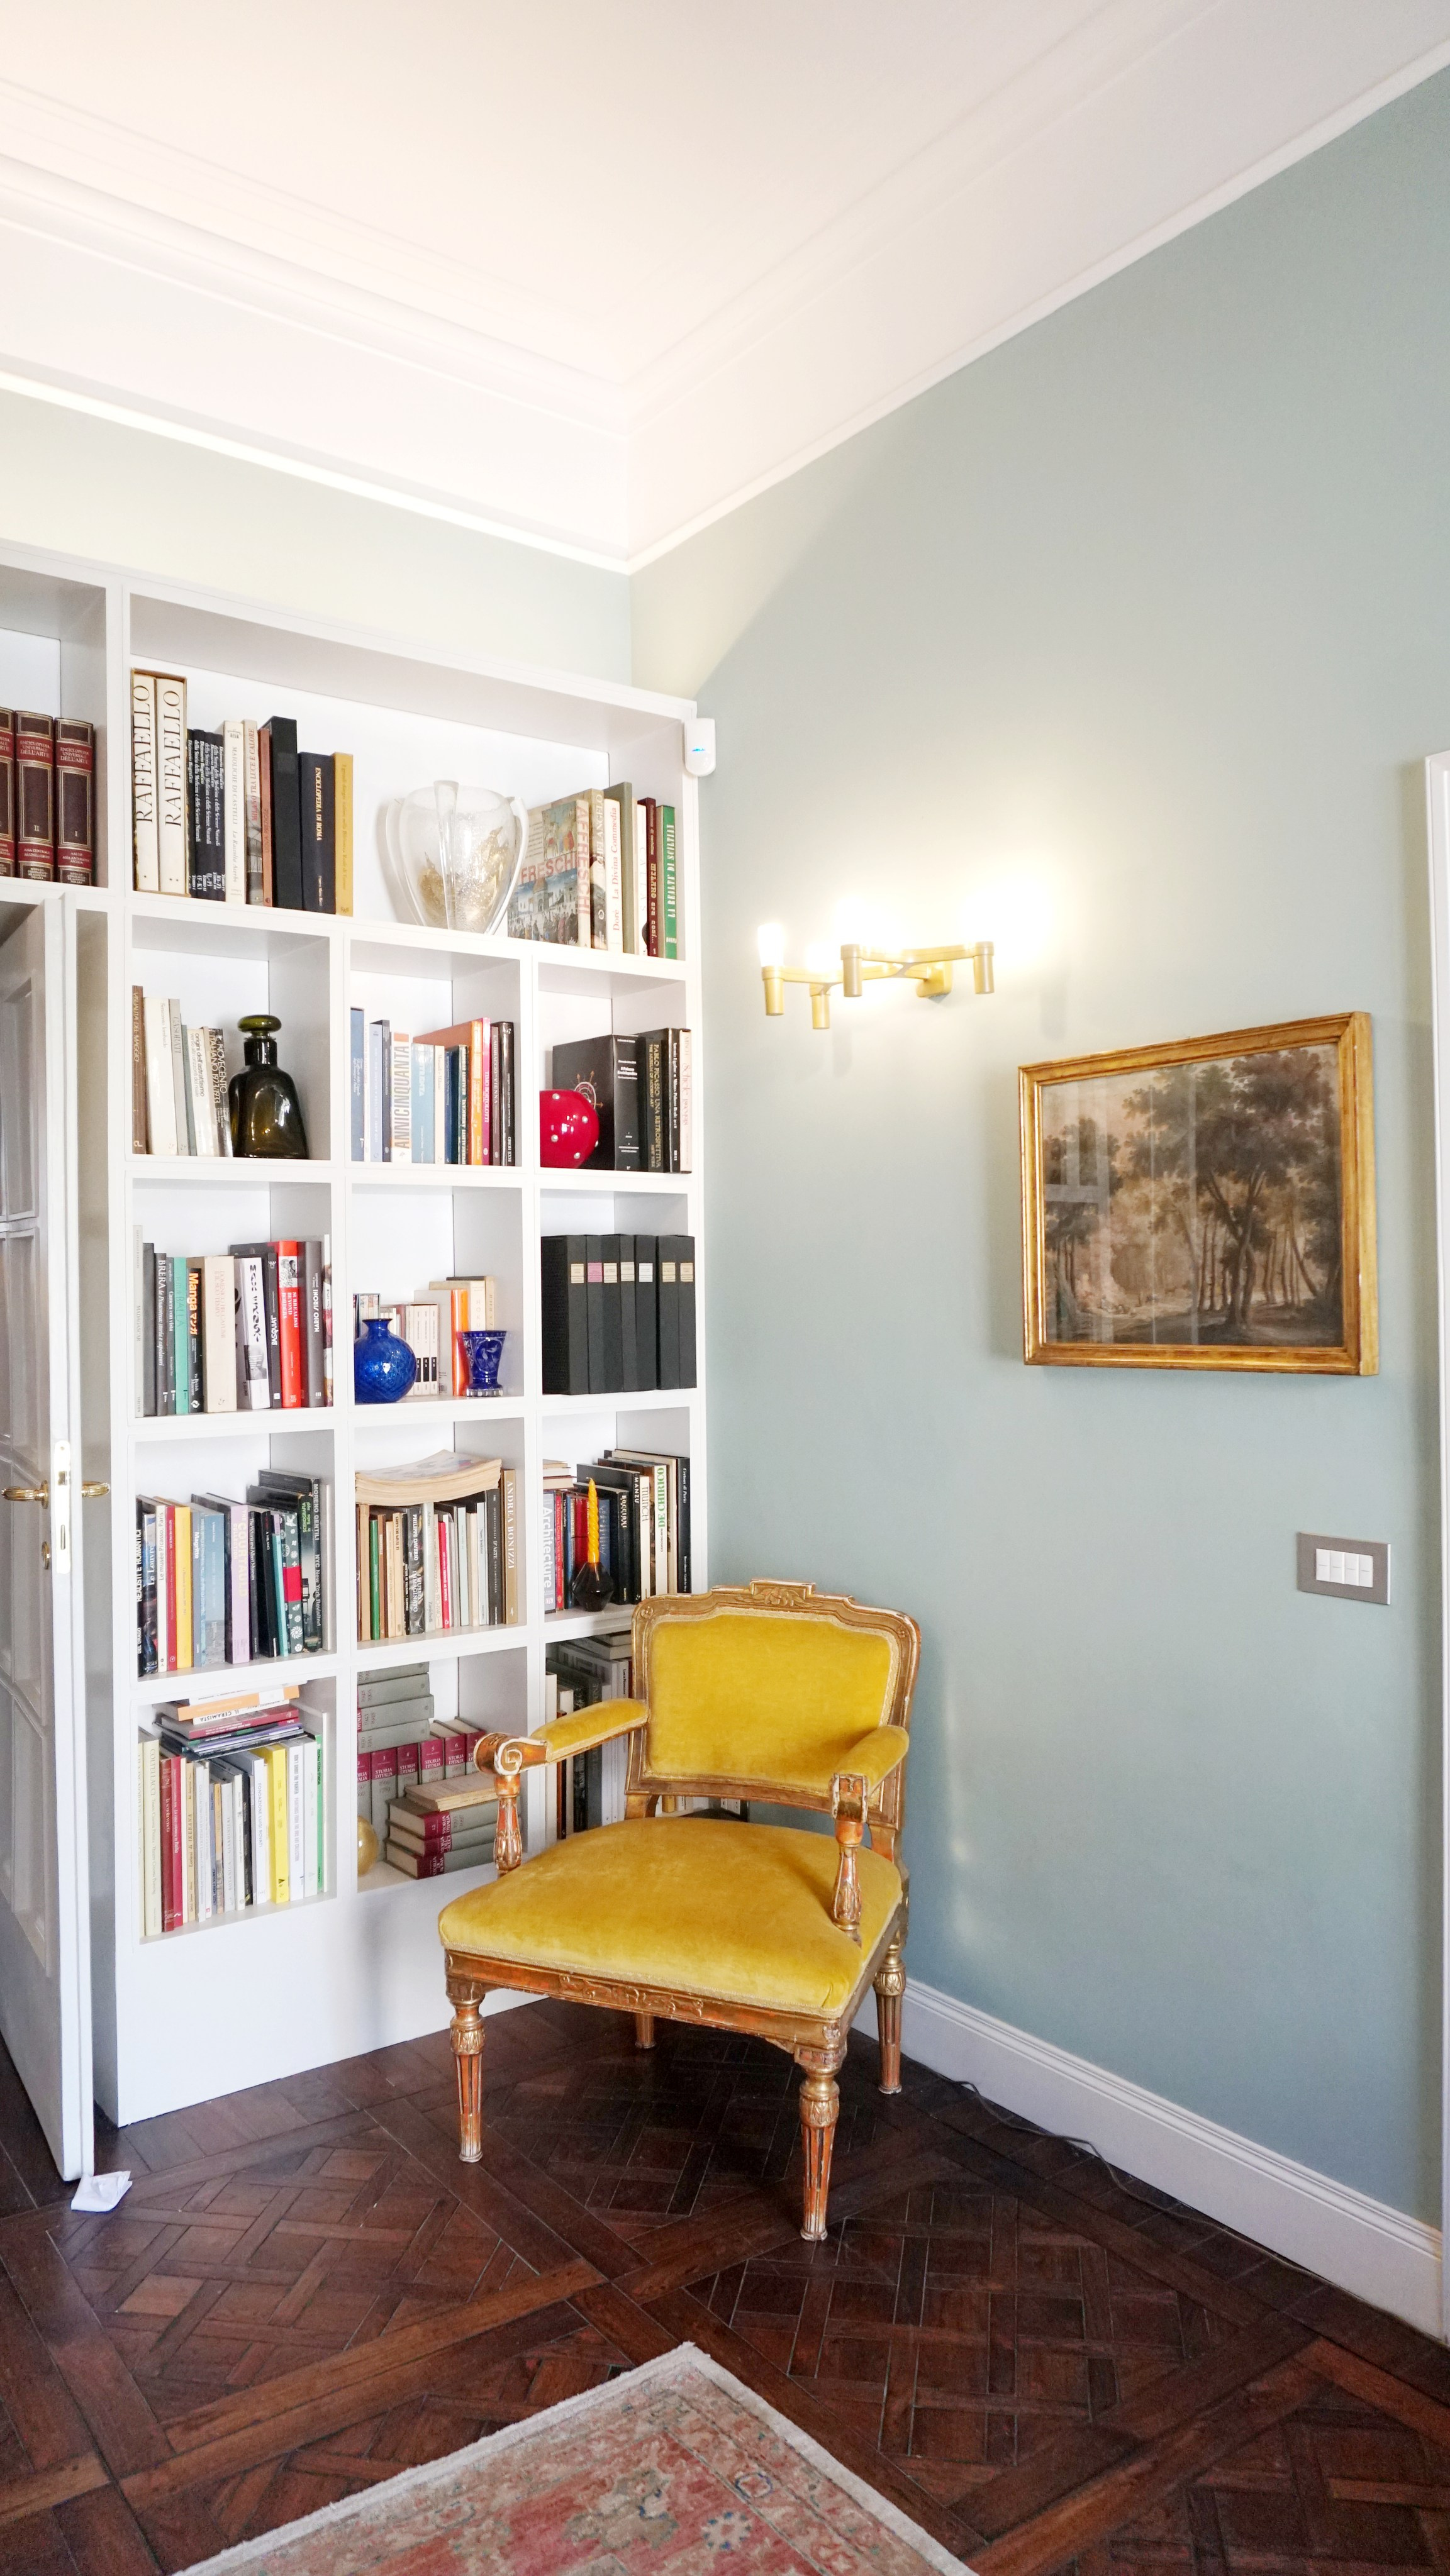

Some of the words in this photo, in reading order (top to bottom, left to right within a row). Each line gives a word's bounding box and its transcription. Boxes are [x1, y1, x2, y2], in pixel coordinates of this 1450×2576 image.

[21, 749, 49, 757] DELL'ARTE
[60, 756, 88, 764] DELL'ARTE
[133, 686, 153, 823] RAFFAELLO
[163, 691, 181, 826] RAFFAELLO
[232, 785, 237, 793] DI
[666, 824, 674, 860] SCILTIAN
[577, 806, 590, 915] AFFRESCHI
[667, 863, 675, 872] DI
[613, 888, 619, 899] La
[667, 908, 676, 918] LA
[173, 1016, 181, 1053] CASORATI
[209, 1035, 218, 1071] ITALIANO
[217, 1043, 227, 1094] NOVECENTO
[196, 1052, 205, 1097] dell'astrattismo
[212, 1074, 221, 1103] 1923/1933
[682, 1063, 691, 1096] Schiele
[394, 1045, 410, 1149] ANNICINQUANTA
[158, 1260, 166, 1289] BRERA
[187, 1272, 199, 1311] Manga
[189, 1311, 198, 1336] マンガ
[658, 1514, 666, 1528] DE
[238, 1522, 248, 1597] COURTAULD
[543, 1507, 554, 1589] Architecture
[148, 1572, 155, 1585] Le
[199, 1712, 232, 1722] CERAMISTA
